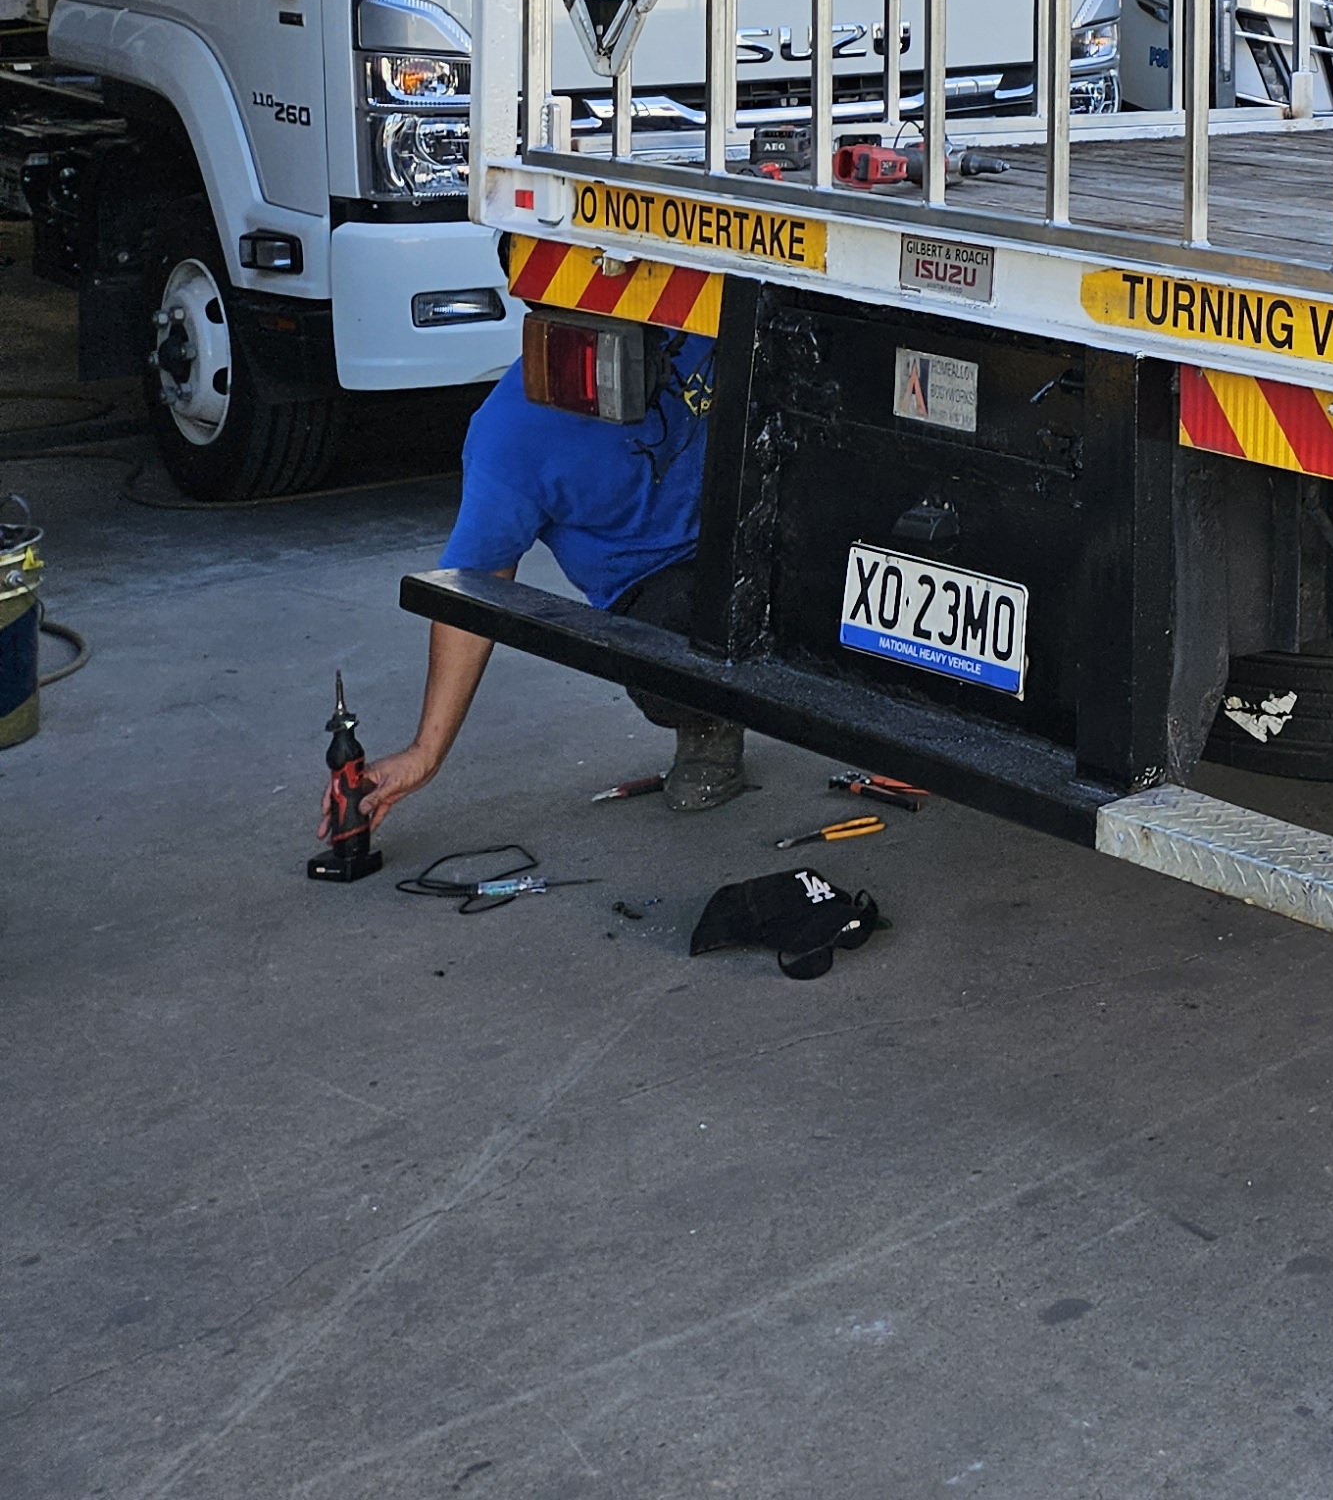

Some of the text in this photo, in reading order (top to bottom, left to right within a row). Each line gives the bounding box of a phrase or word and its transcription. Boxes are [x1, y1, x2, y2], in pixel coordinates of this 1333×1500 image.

[736, 21, 912, 65] SUZU
[252, 91, 312, 127] 110 260
[763, 142, 787, 151] AEG
[605, 189, 655, 233] NOT
[662, 199, 806, 263] OVERTAKE
[906, 240, 990, 266] GILBERT & ROACH
[915, 258, 977, 287] ISUZU
[1121, 273, 1294, 351] TURNING
[849, 556, 1016, 662] XO 23MO
[878, 637, 982, 676] NATIONAL HEAVY VEHICLE
[794, 871, 836, 904] LA
